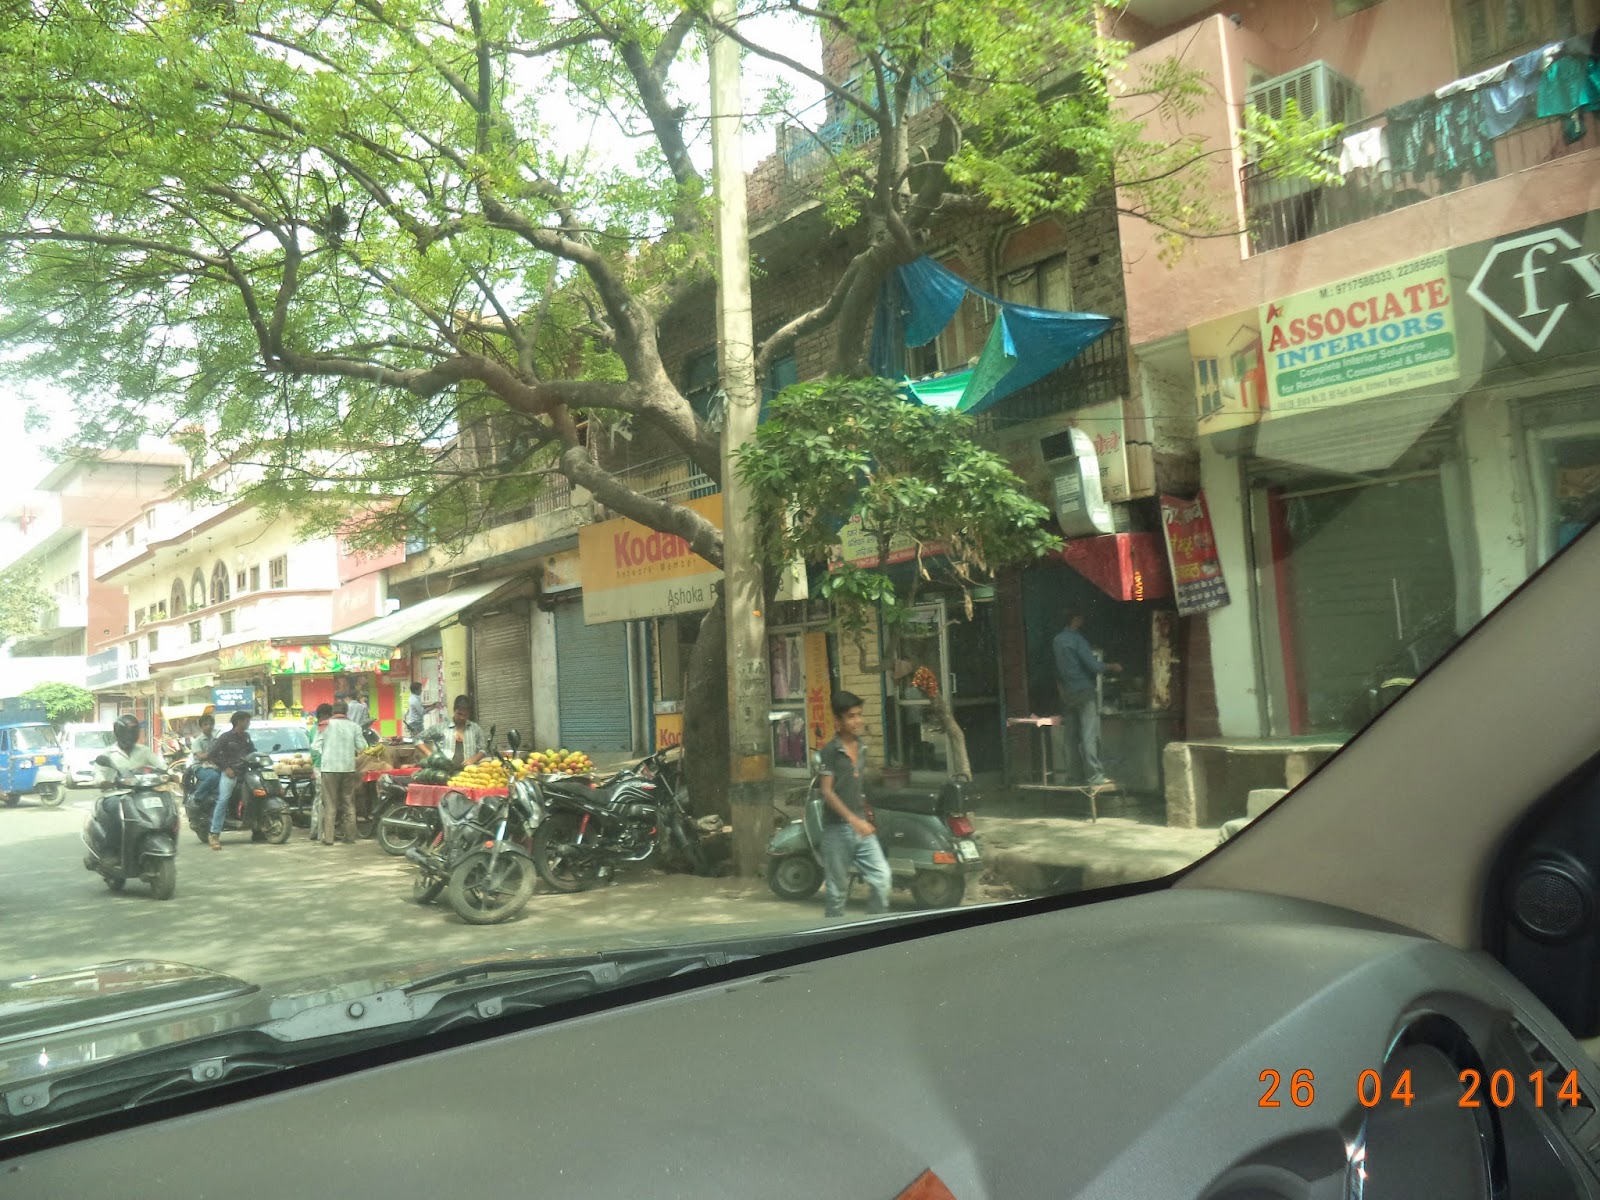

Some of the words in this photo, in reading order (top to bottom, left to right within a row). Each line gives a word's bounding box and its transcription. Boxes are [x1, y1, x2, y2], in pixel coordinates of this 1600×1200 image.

[1268, 277, 1450, 352] ASSOCIATE
[1276, 311, 1445, 370] INTERIORS
[1299, 360, 1342, 378] Complete
[1342, 351, 1377, 367] Interior
[1380, 341, 1426, 359] Solutions
[1281, 384, 1295, 394] for
[1345, 358, 1403, 379] Commercial
[1404, 355, 1413, 365] &
[668, 586, 704, 606] Ashoka
